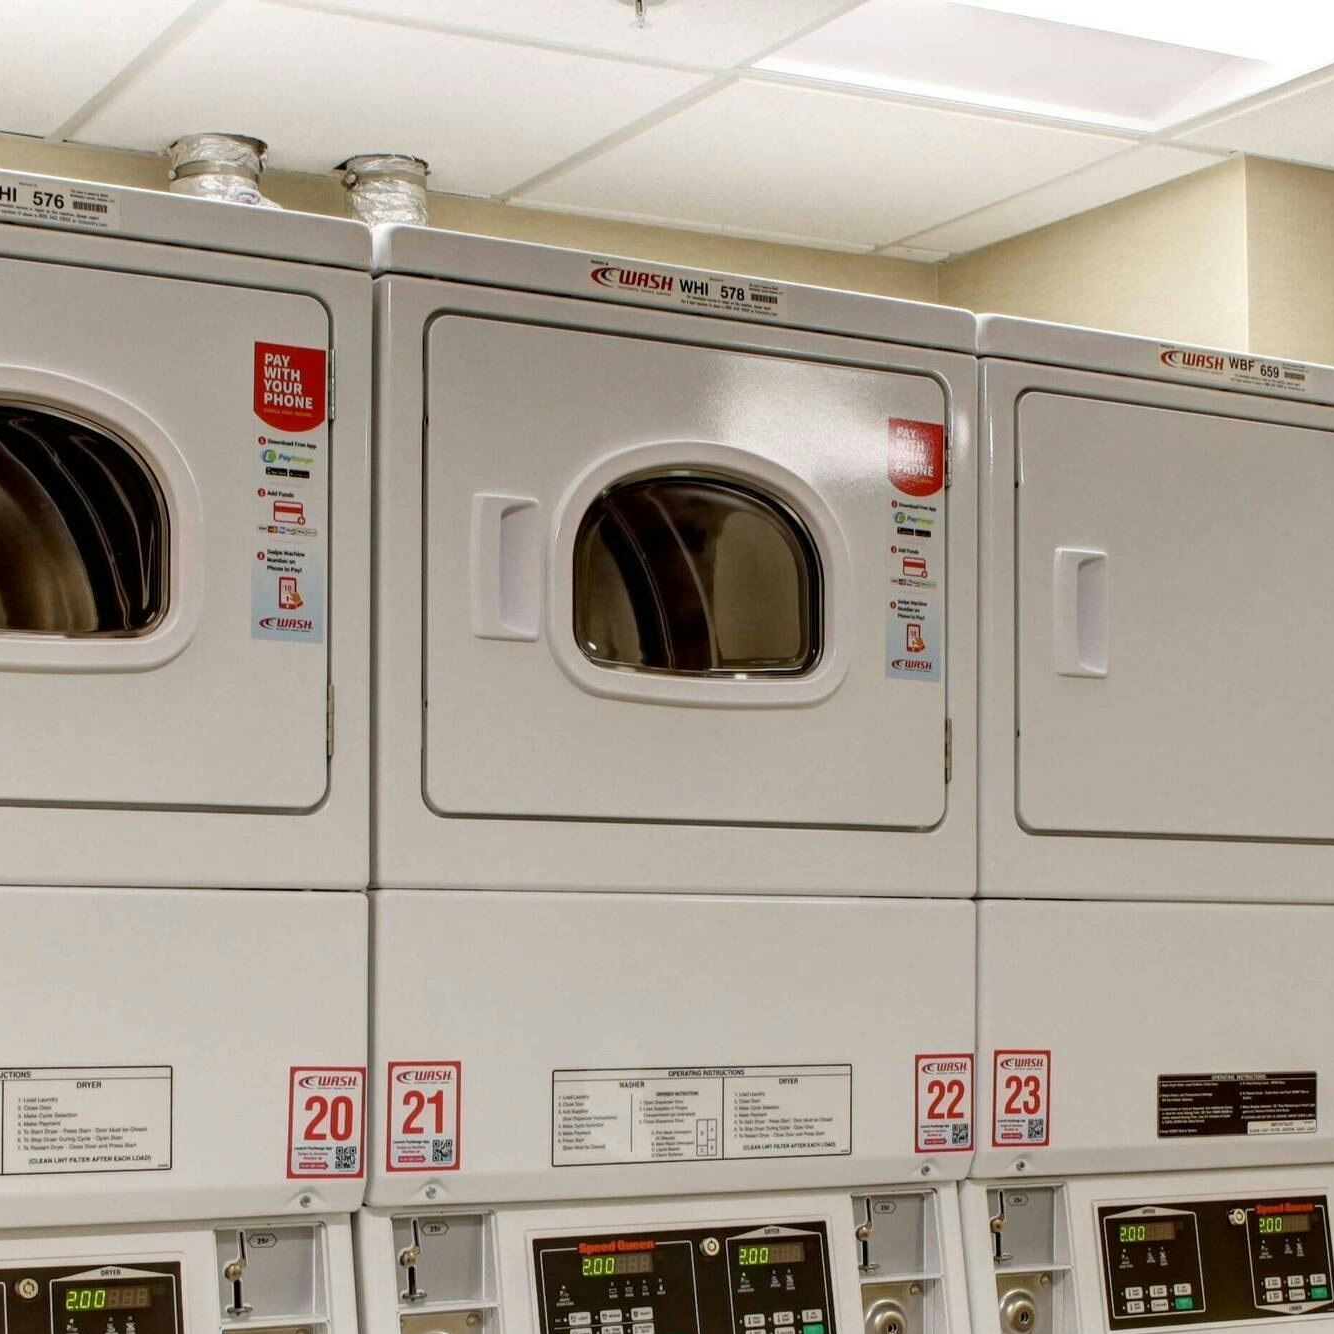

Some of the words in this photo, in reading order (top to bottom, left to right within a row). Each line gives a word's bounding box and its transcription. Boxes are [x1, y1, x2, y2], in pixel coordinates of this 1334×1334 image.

[33, 191, 65, 209] 576
[619, 269, 673, 291] WASH
[679, 279, 709, 296] WHI
[720, 286, 745, 301] 578
[264, 352, 290, 367] PAY
[1182, 352, 1224, 370] WASH
[1229, 357, 1255, 372] WBF
[1260, 364, 1279, 378] 659
[264, 366, 300, 382] WITH
[263, 378, 302, 395] YOUR
[264, 392, 313, 410] PHONE
[277, 618, 313, 630] WASH
[905, 659, 932, 670] WASH
[937, 1062, 967, 1072] WASH
[1015, 1058, 1044, 1067] WASH
[318, 1075, 357, 1086] WASH
[415, 1070, 451, 1080] WASH
[76, 1081, 102, 1089] DRYER
[927, 1079, 965, 1120] 22
[1004, 1075, 1040, 1115] 23
[304, 1095, 354, 1141] 20
[402, 1090, 443, 1135] 21
[579, 1241, 616, 1255] Speed
[617, 1240, 655, 1250] Queen
[739, 1247, 768, 1265] 2.00
[582, 1257, 615, 1276] 2.00
[66, 1289, 106, 1309] 2.00
